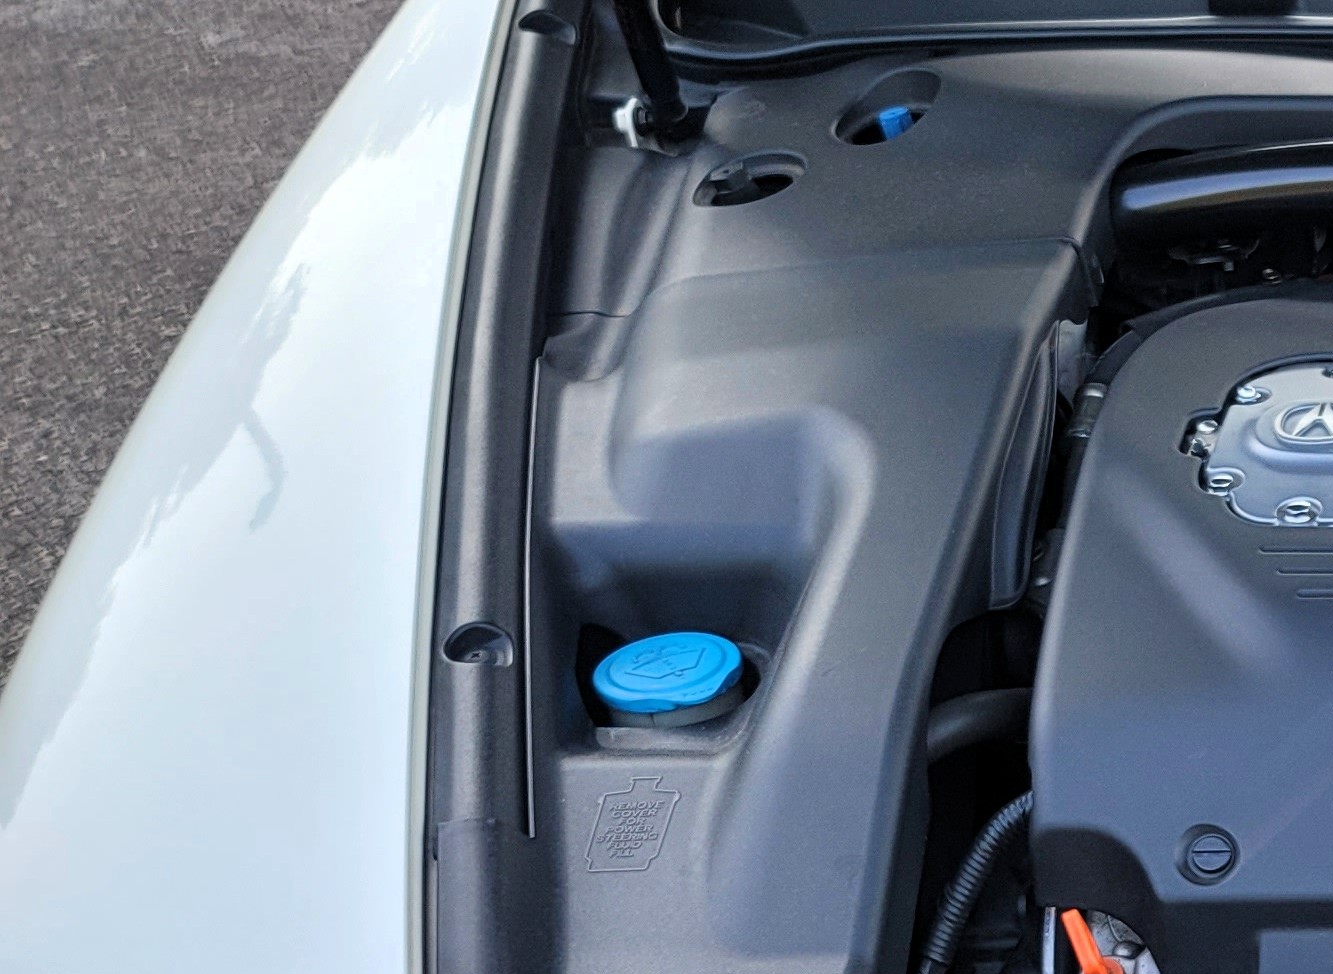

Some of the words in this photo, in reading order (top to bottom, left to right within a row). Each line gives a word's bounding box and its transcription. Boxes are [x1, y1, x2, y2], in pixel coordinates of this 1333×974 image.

[610, 801, 665, 812] REMOVE
[612, 809, 659, 820] COVER
[619, 817, 648, 826] FOR
[604, 824, 654, 835] POWER
[596, 832, 659, 844] STEERING
[607, 841, 643, 851] FLUID
